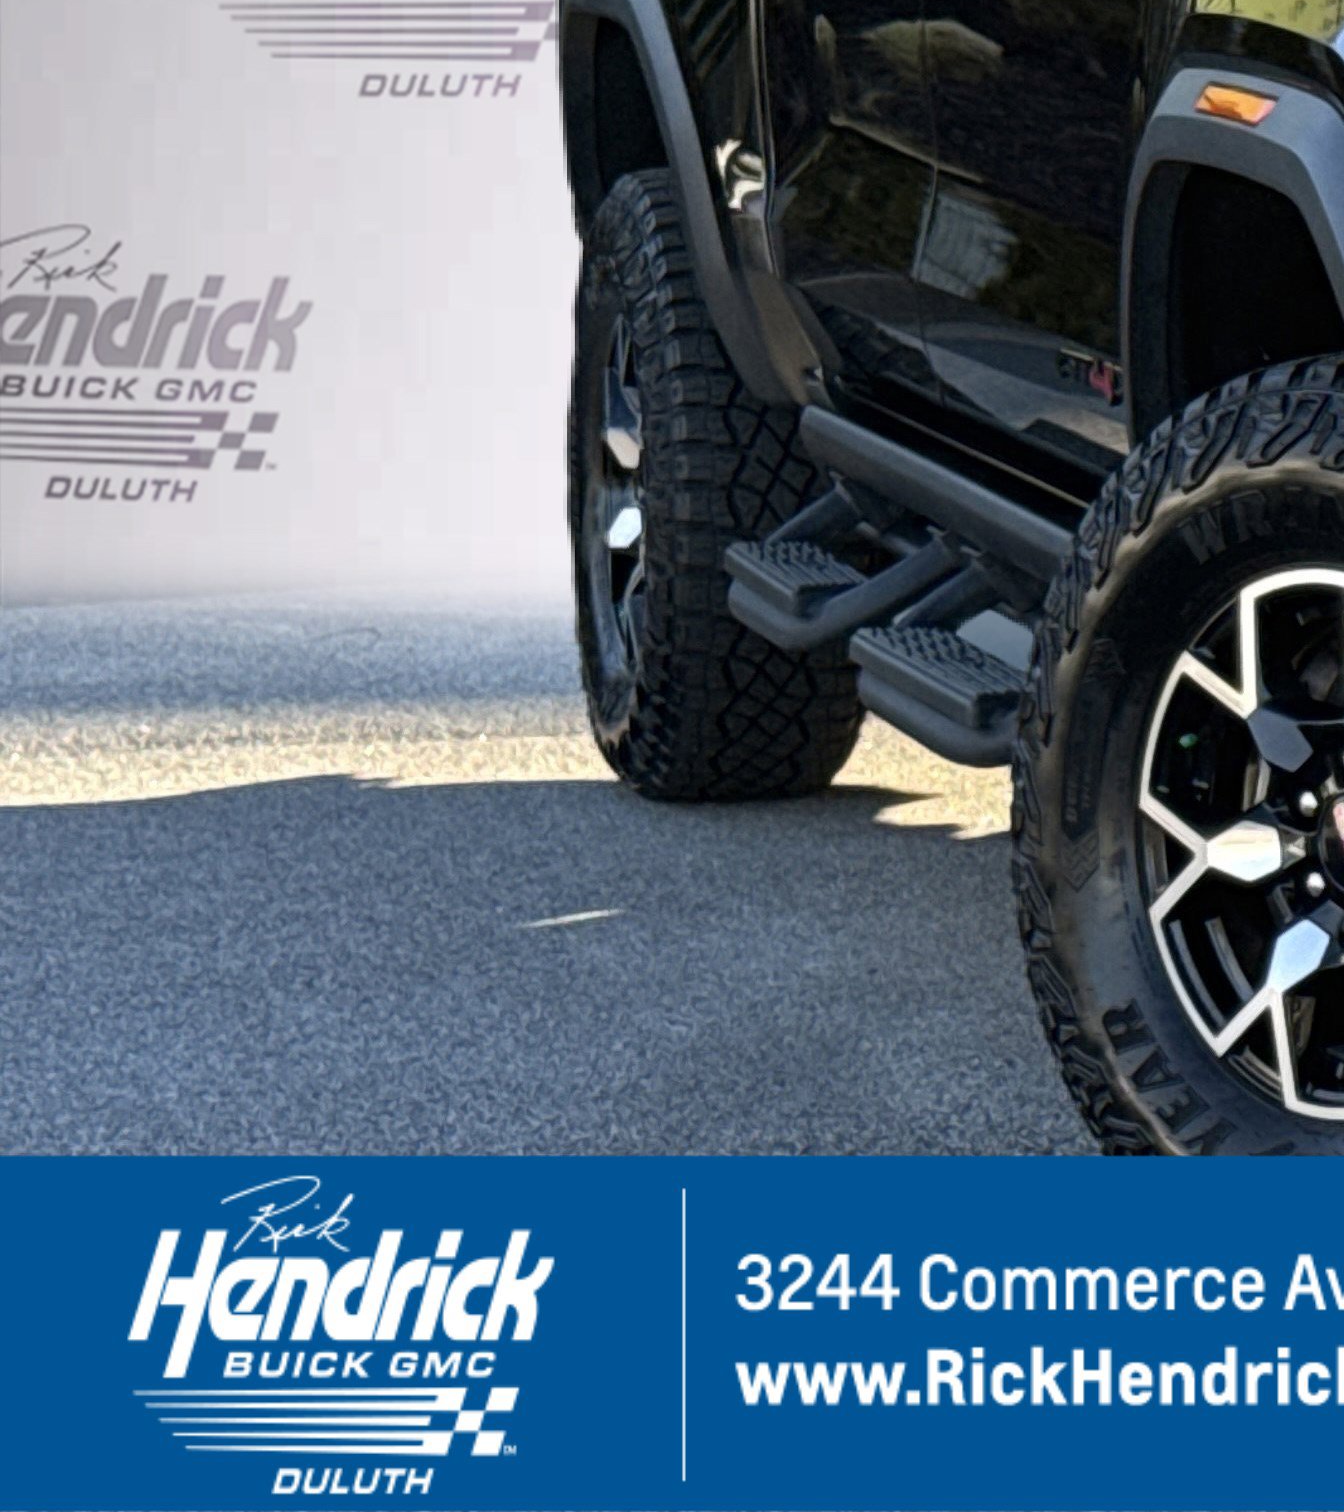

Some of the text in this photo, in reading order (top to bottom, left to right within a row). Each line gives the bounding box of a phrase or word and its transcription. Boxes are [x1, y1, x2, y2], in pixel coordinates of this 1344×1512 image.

[359, 74, 521, 97] DULUTH
[0, 273, 313, 373] endrick
[0, 374, 256, 403] BUICK GMC
[44, 476, 197, 502] DULUTH
